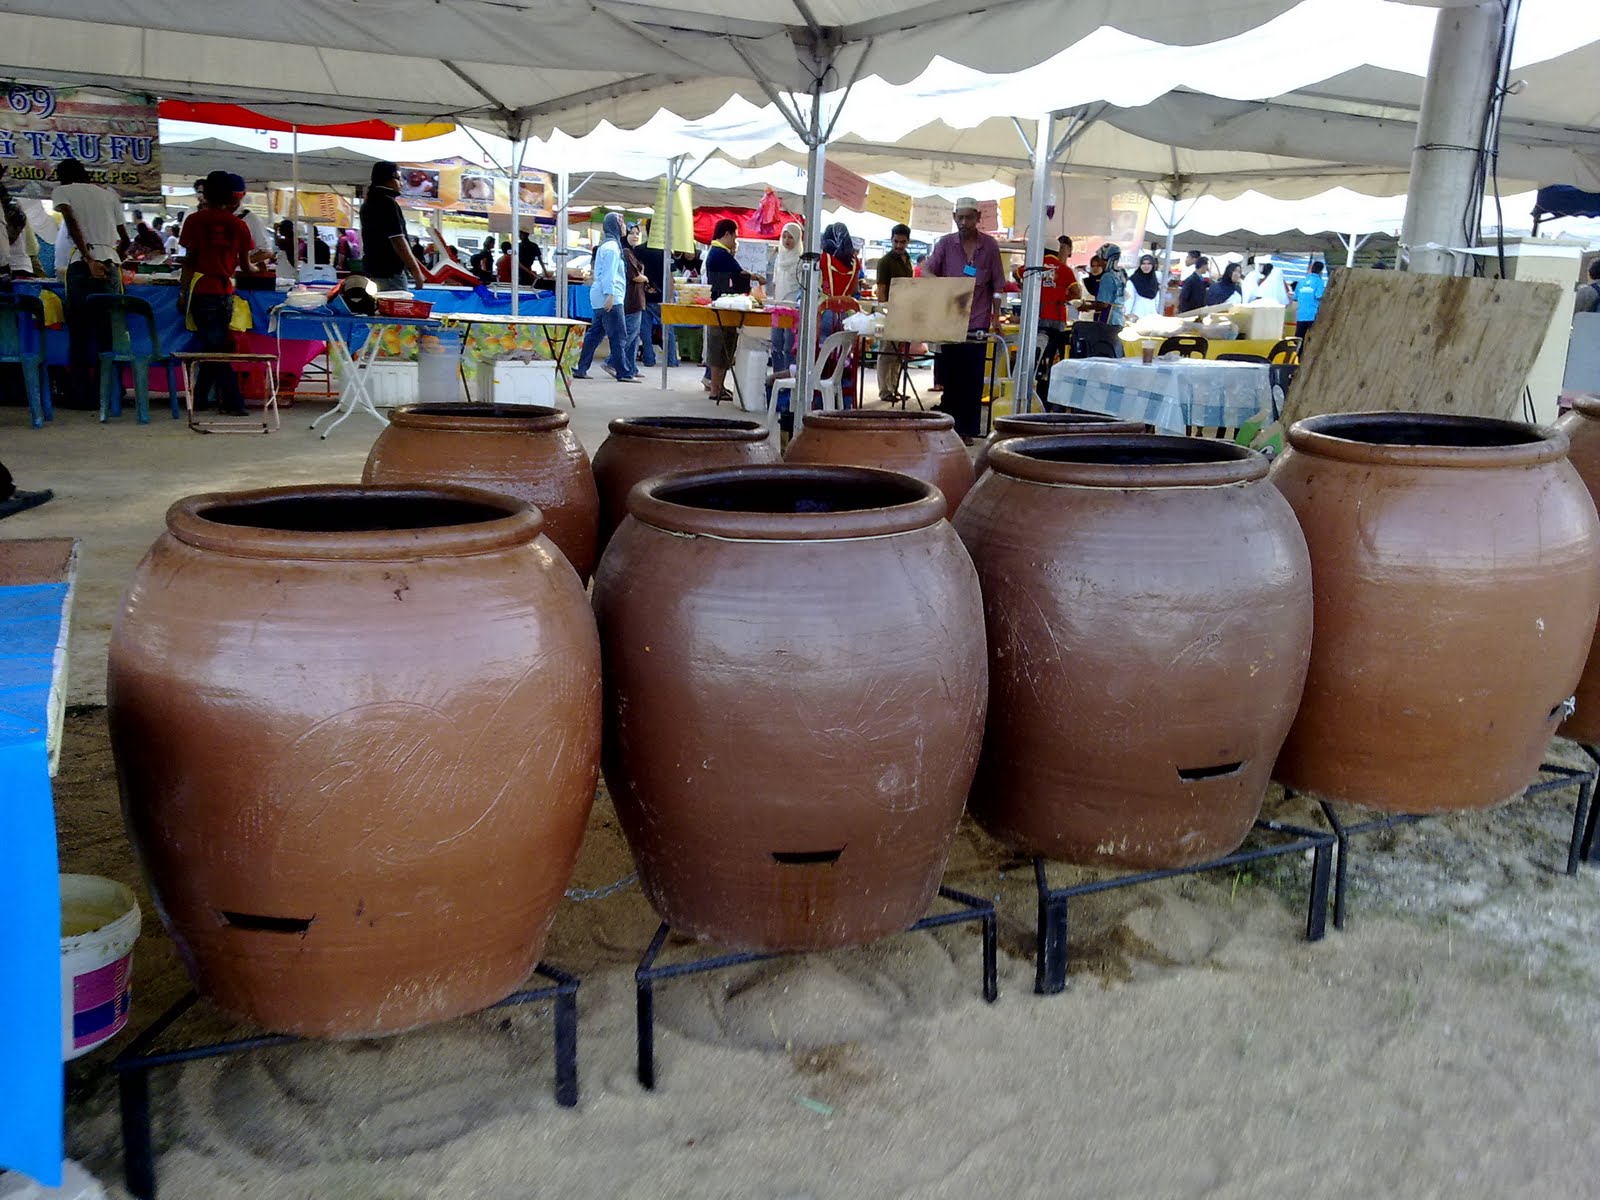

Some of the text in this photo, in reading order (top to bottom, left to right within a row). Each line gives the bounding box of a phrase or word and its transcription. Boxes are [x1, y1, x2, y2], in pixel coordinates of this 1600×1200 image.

[7, 85, 56, 119] 69
[23, 131, 101, 162] TAU
[108, 135, 153, 164] FU
[269, 137, 279, 149] B
[109, 170, 140, 184] PCS
